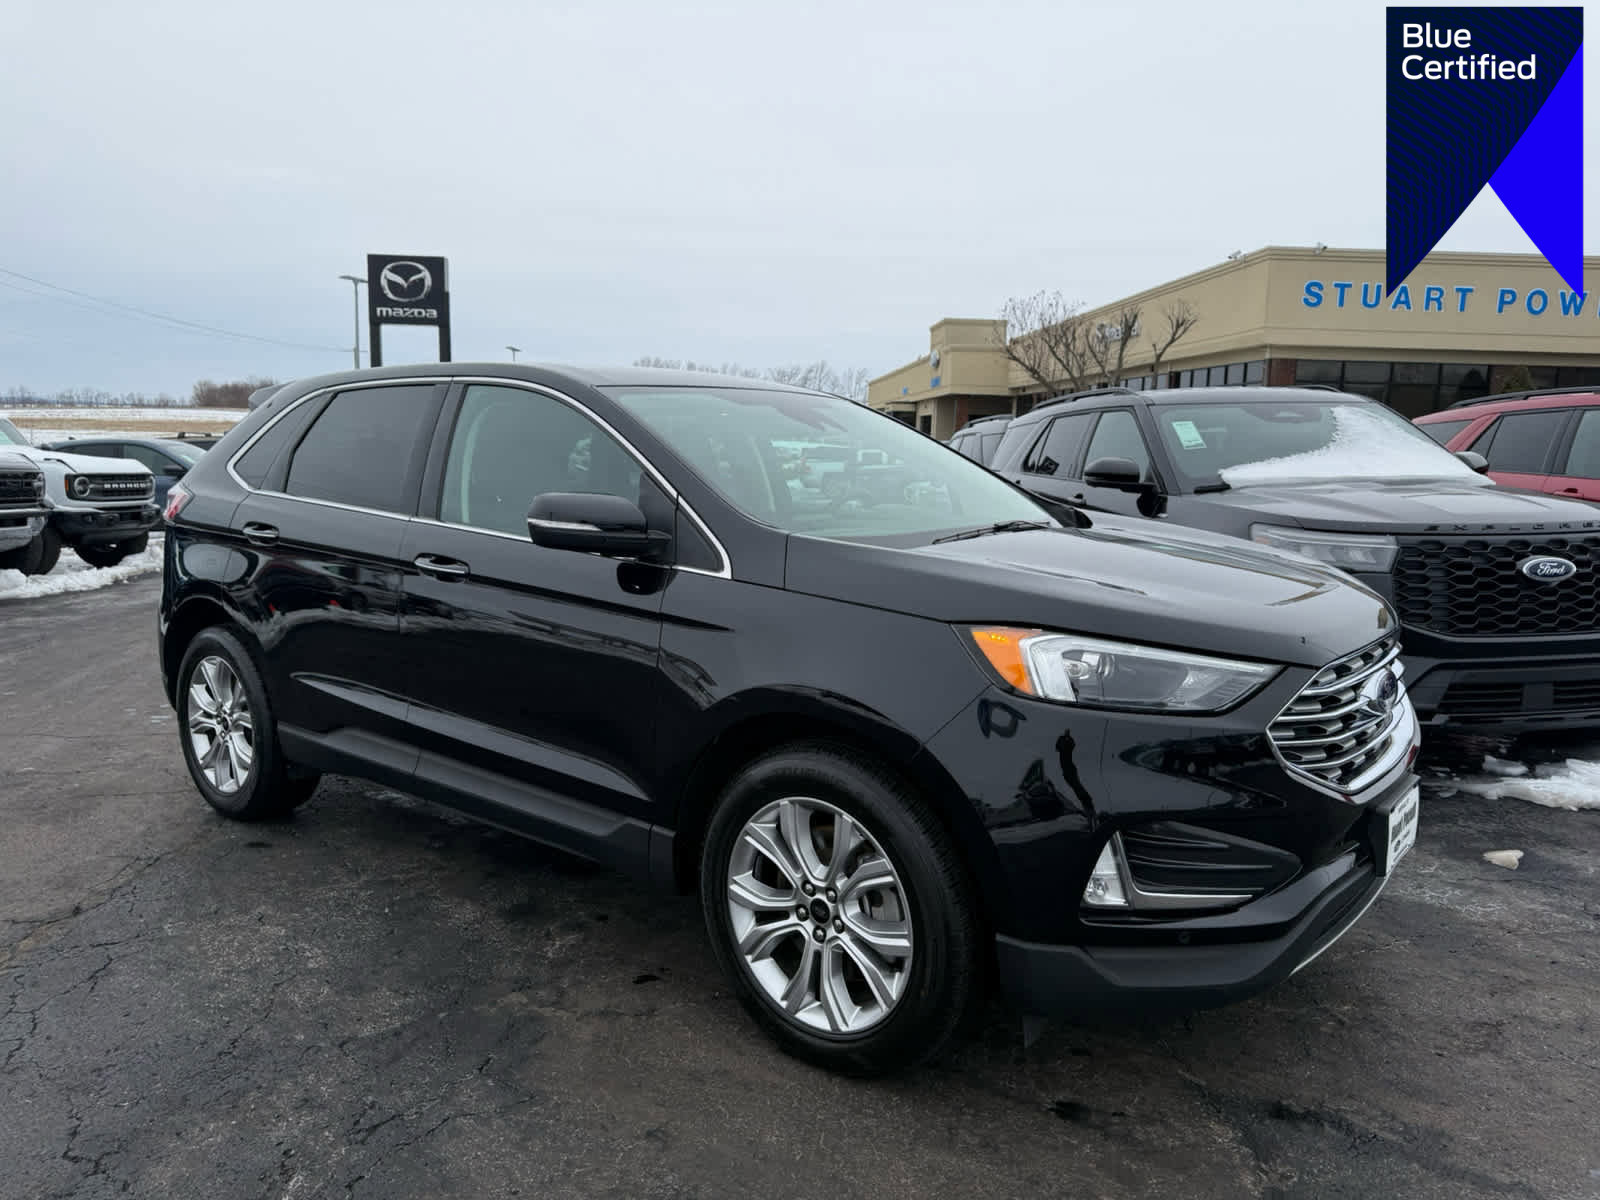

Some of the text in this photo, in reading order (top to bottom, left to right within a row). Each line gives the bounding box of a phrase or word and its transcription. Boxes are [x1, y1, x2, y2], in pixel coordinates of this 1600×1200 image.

[1302, 280, 1600, 318] STUART POW
[376, 307, 437, 318] mazda
[1537, 562, 1566, 576] Ford
